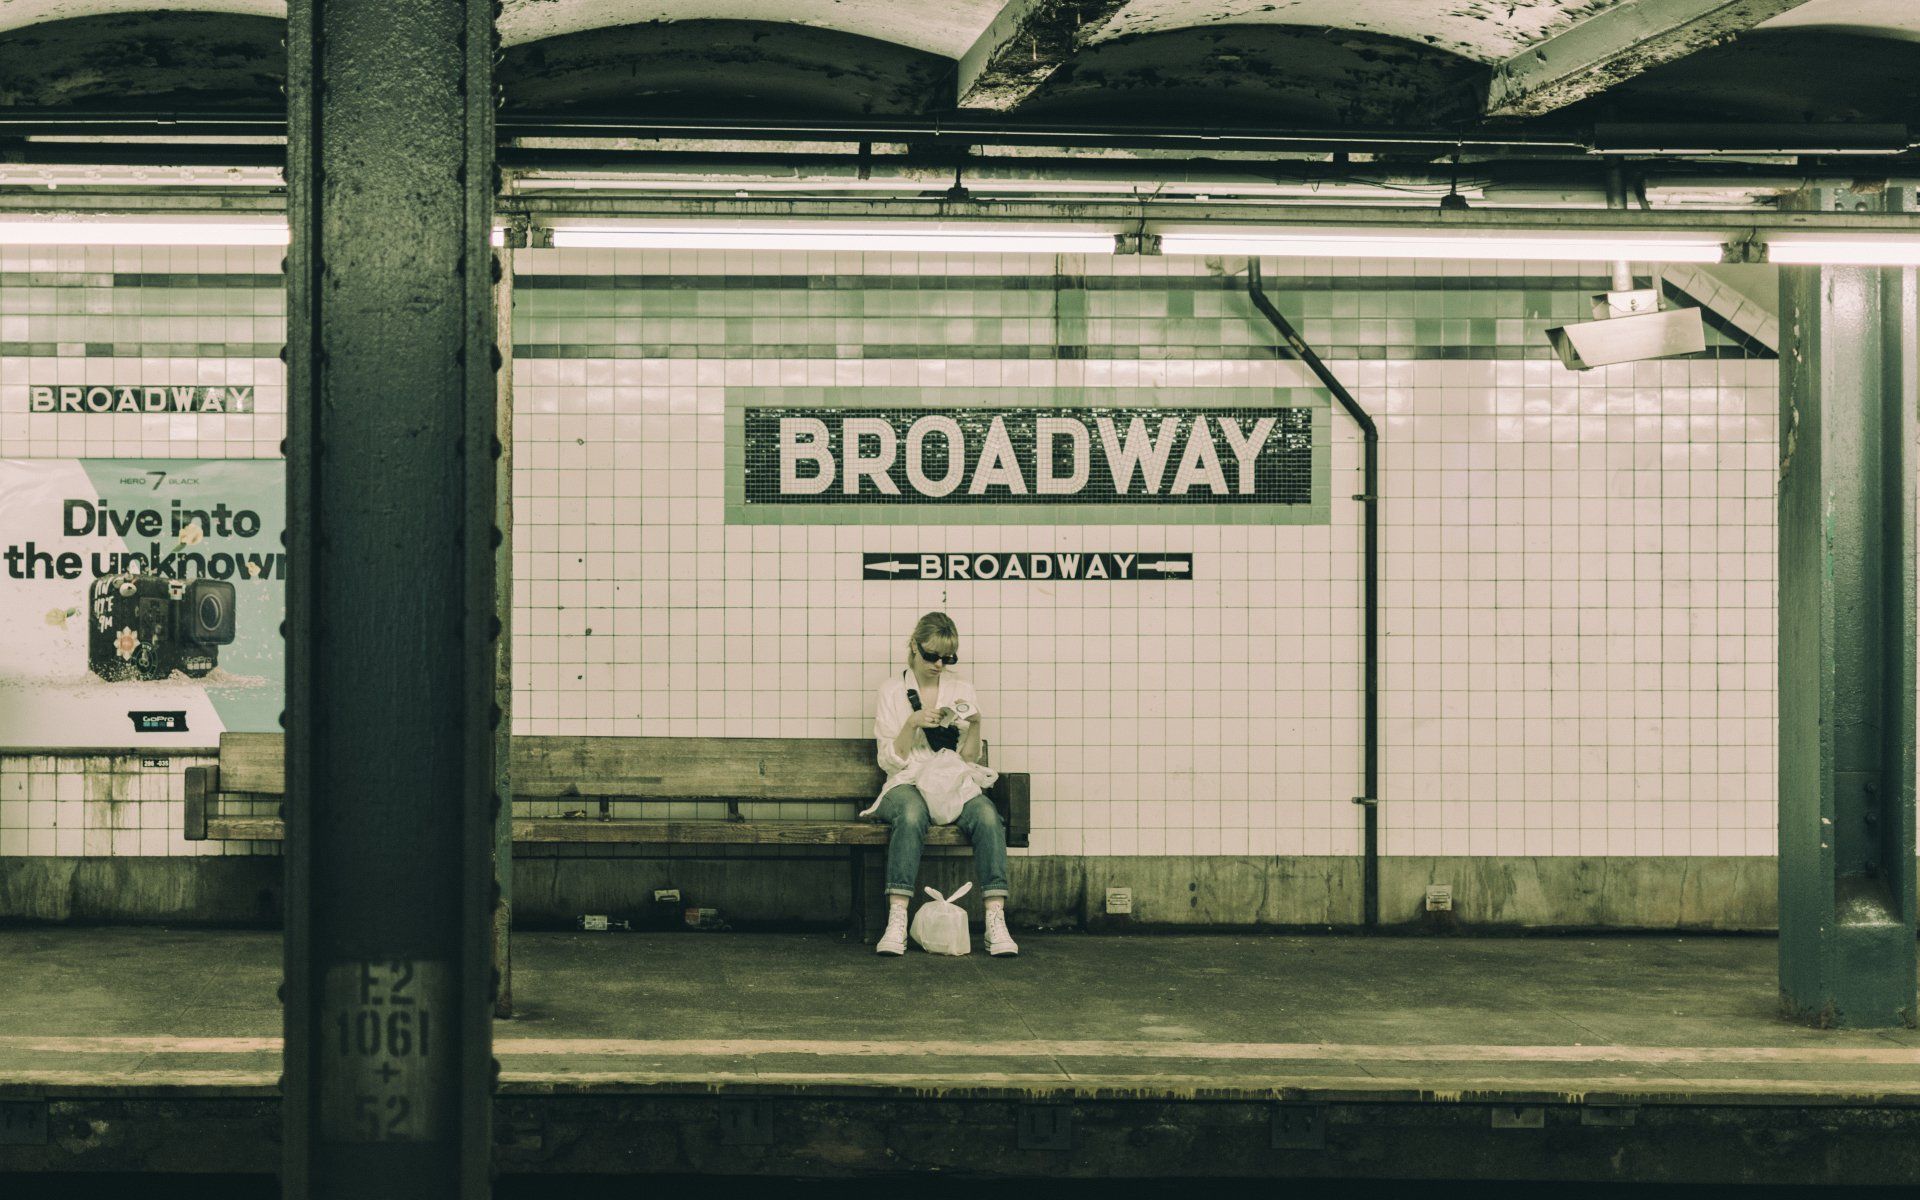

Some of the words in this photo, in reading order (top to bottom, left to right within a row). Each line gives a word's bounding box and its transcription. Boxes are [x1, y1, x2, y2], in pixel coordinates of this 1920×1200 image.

[32, 387, 251, 412] BROADWAY
[779, 415, 1276, 497] BROADWAY
[146, 471, 167, 490] 7
[63, 499, 163, 537] Dive
[171, 499, 261, 538] into
[4, 542, 82, 579] the
[920, 554, 1137, 580] BROADWAY
[360, 960, 414, 1004] E2
[338, 1009, 429, 1057] 1061
